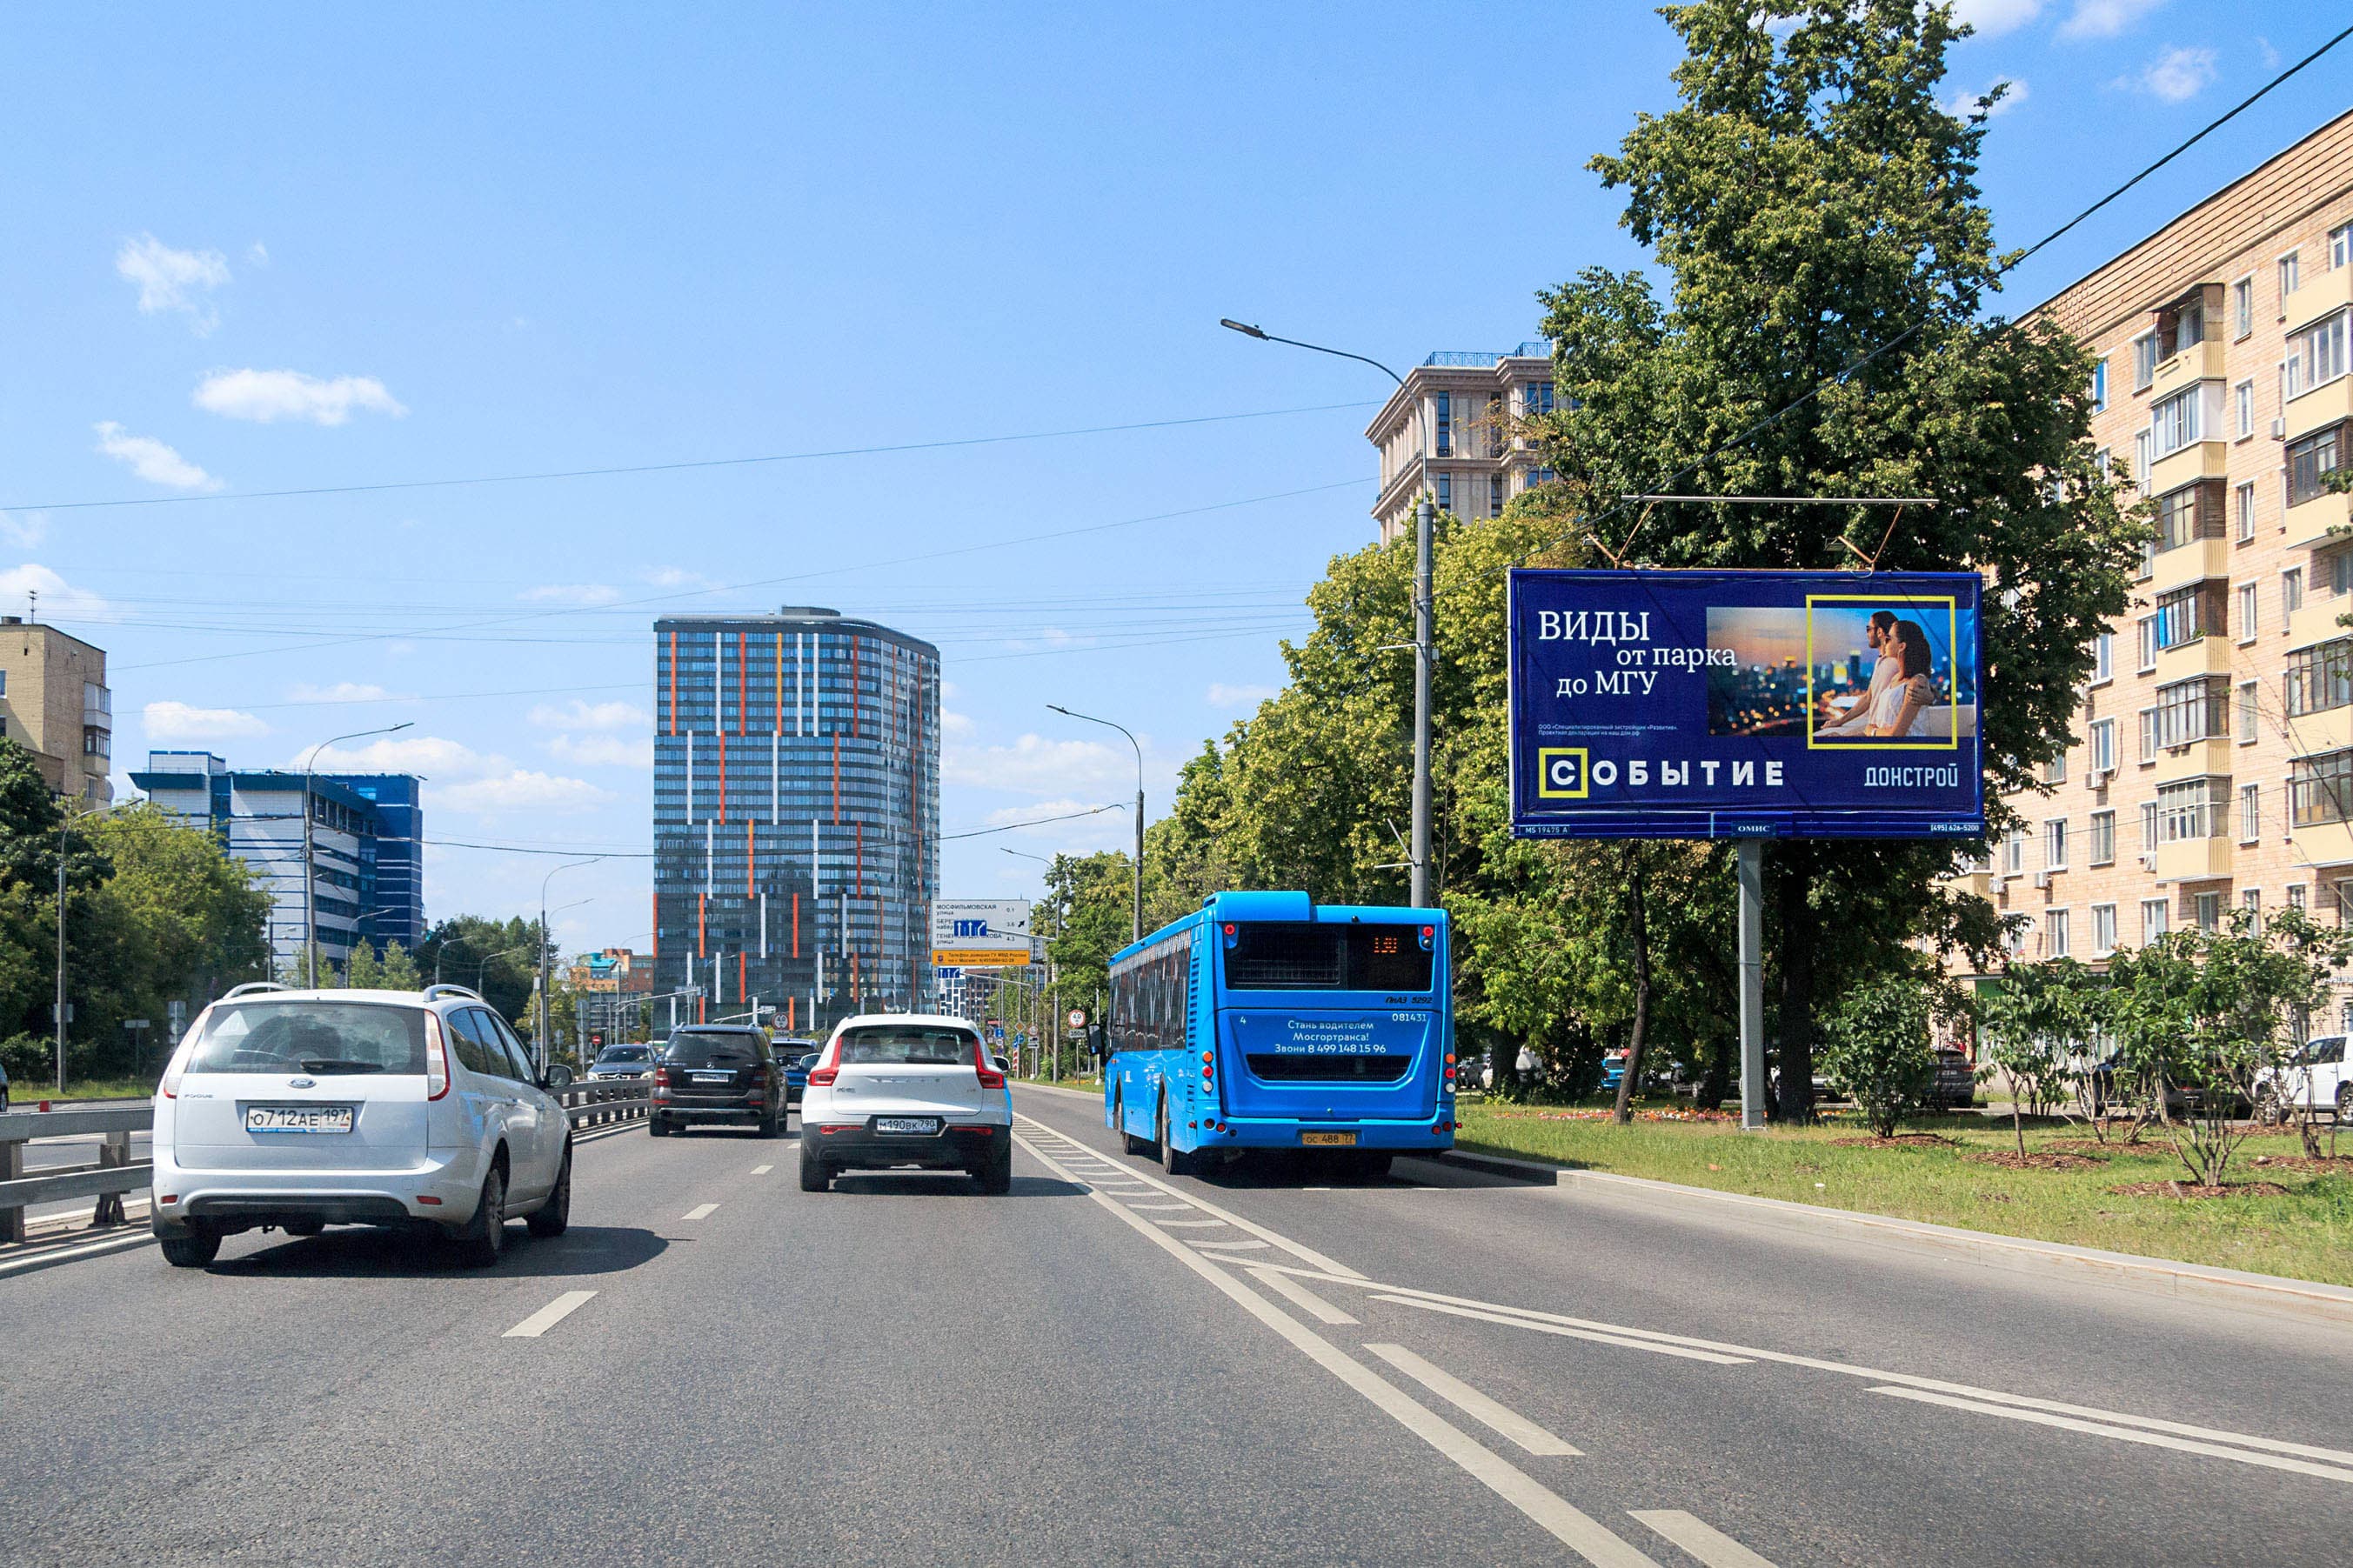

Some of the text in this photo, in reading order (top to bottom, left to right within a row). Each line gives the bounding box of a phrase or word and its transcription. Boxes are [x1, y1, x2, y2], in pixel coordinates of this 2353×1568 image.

[1538, 611, 1650, 647] ВИДЫ
[1616, 647, 1738, 673] от парка
[1556, 671, 1659, 698] до МГУ
[1550, 759, 1784, 786] СОБЫТИЕ
[1864, 763, 1959, 787] ДОНСТРОЙ
[1240, 1016, 1247, 1025] 4
[1287, 1019, 1374, 1031] Стань водителем
[1392, 1013, 1427, 1023] 081431
[1293, 1032, 1369, 1042] Мосгортранса!
[1274, 1044, 1387, 1054] Звони 8 499 148 15 96
[323, 1109, 349, 1123] 197
